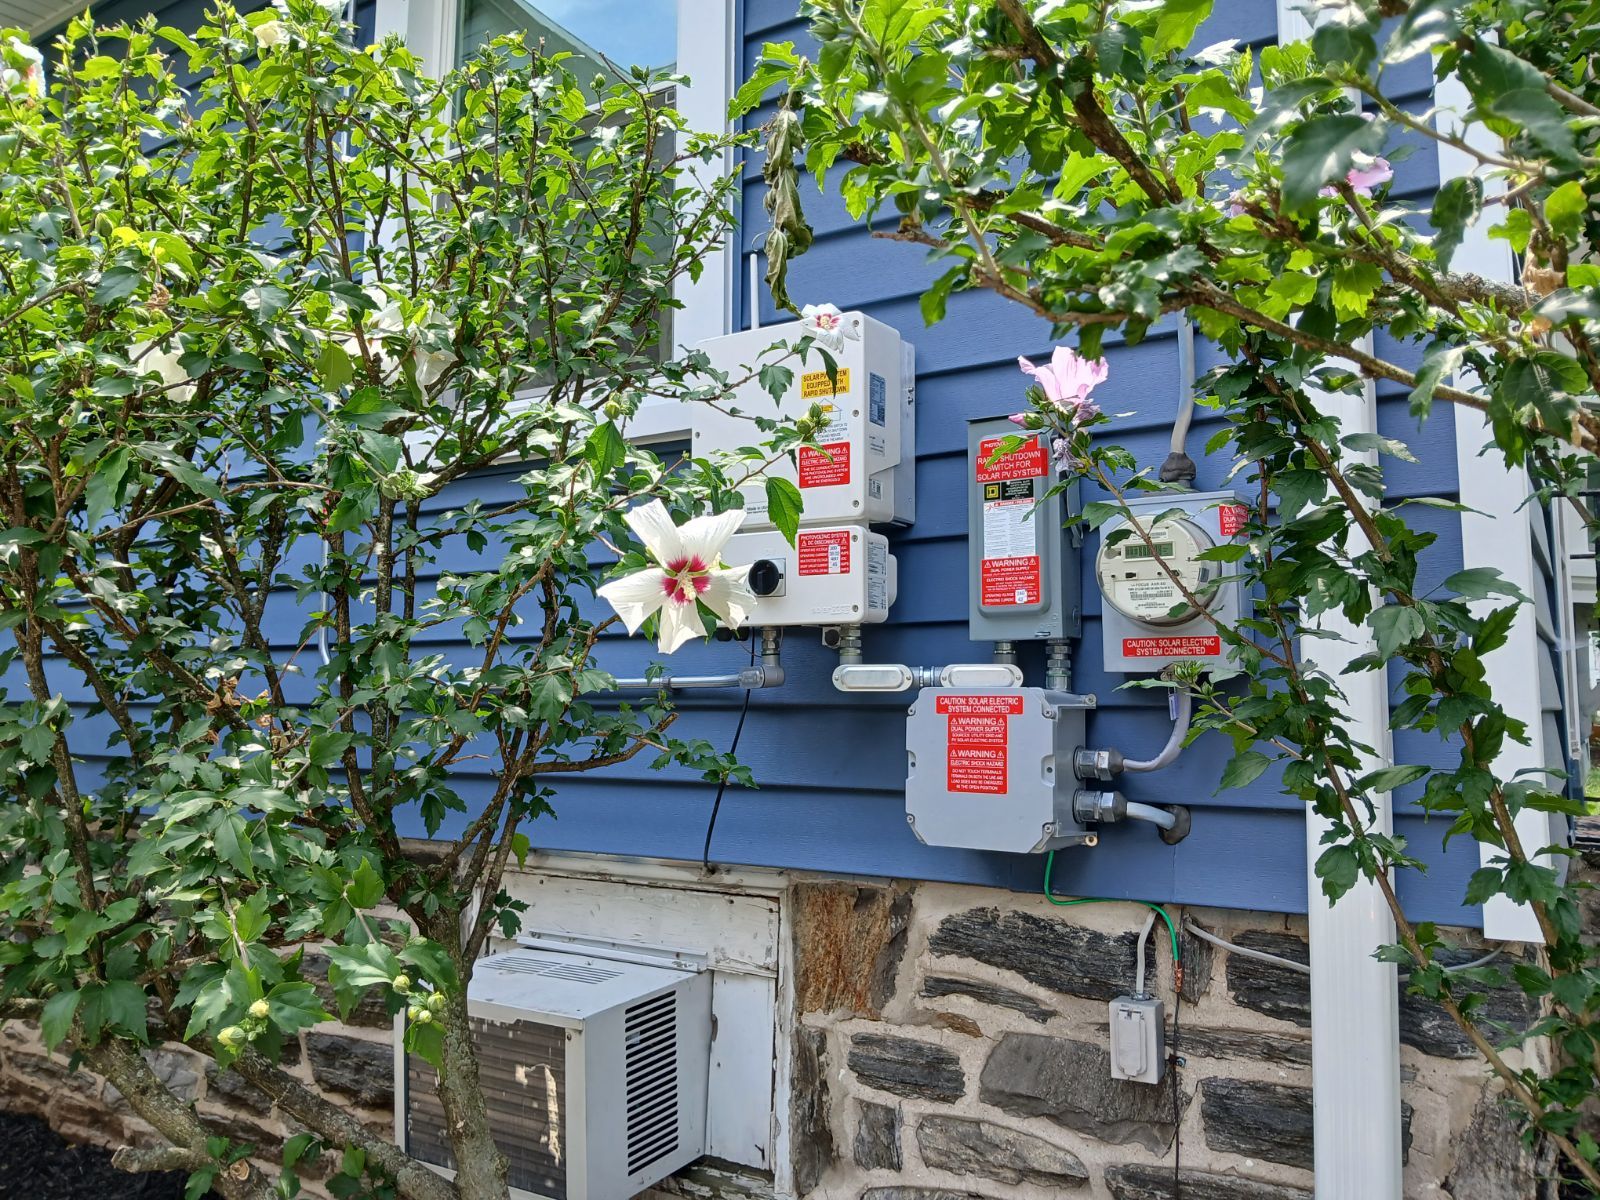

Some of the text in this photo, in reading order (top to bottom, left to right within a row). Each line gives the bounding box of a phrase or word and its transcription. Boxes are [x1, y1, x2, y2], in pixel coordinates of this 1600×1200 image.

[1000, 451, 1040, 462] SHUTDOWN
[1016, 460, 1030, 468] FOR
[978, 472, 1000, 481] SOLAR
[1013, 468, 1041, 477] SYSTEM
[992, 558, 1028, 567] WARNING
[1127, 638, 1215, 648] CAUTION: SOLAR ELECTRIC
[1136, 646, 1206, 656] SYSTEM CONNECTED
[940, 697, 1019, 705] CAUTION: SOLAR ELECTRIC
[948, 705, 971, 713] SYSTEM
[957, 749, 996, 758] WARNING
